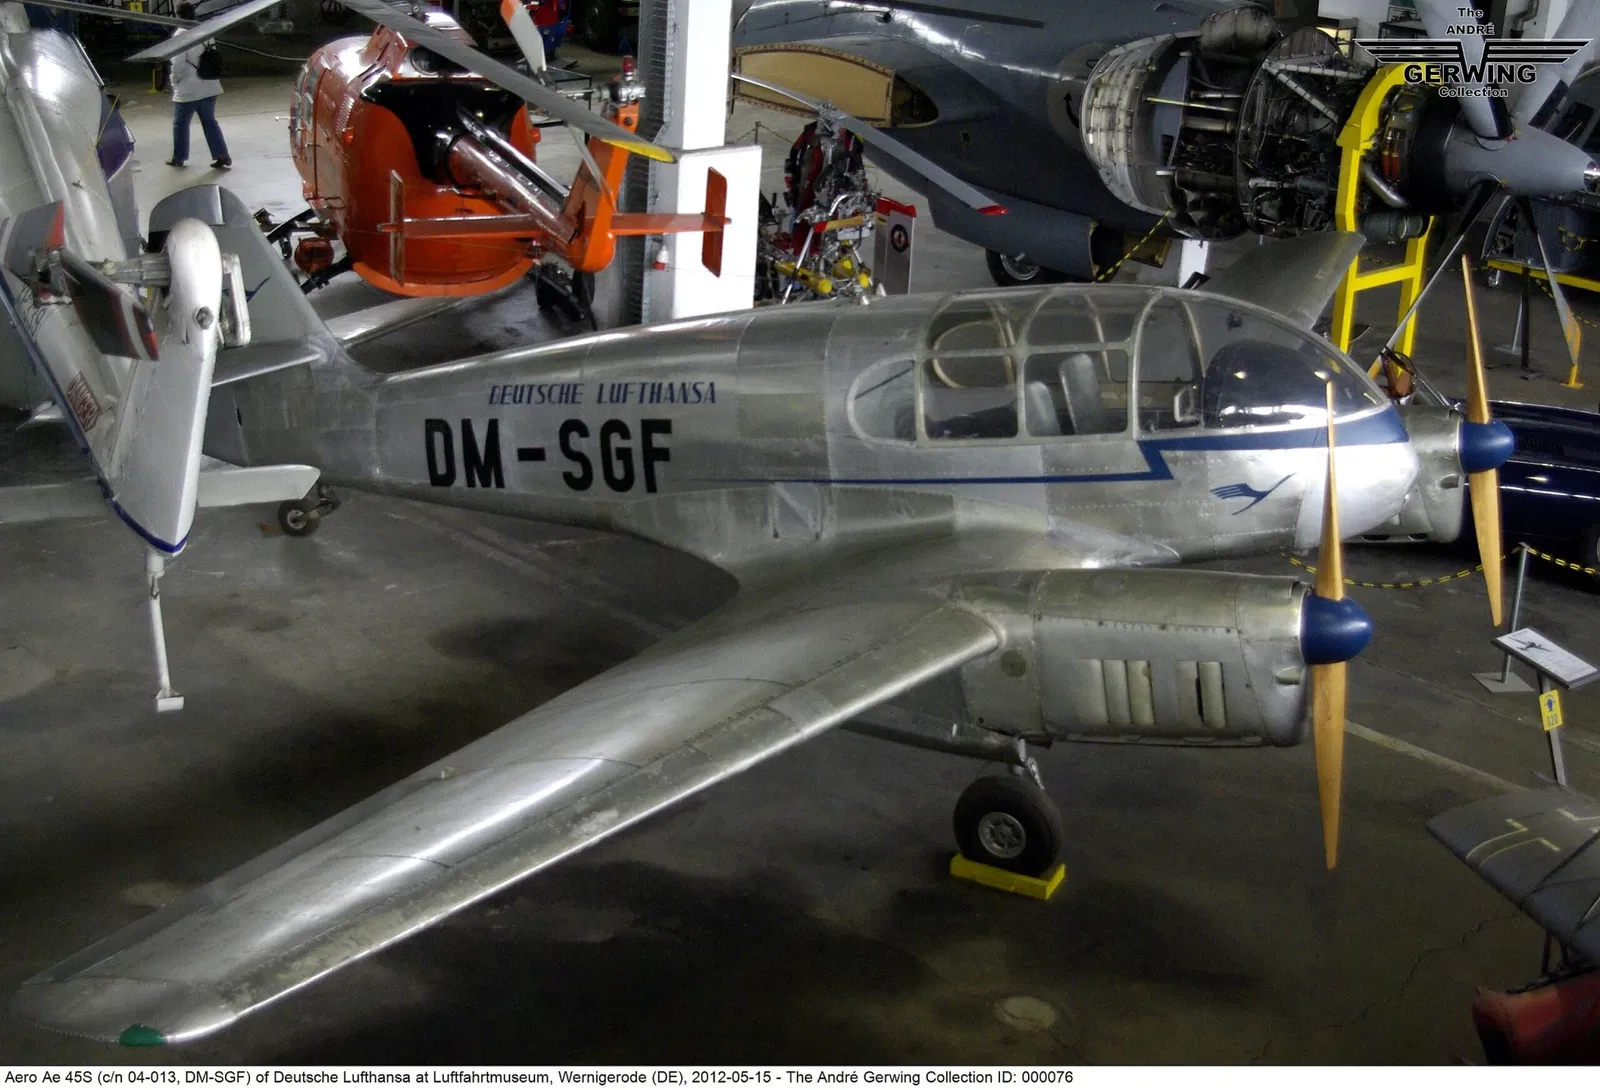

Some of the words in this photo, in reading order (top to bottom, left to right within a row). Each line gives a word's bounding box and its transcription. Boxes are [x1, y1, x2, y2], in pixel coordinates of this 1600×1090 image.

[488, 382, 585, 405] DEUTSCHE
[597, 381, 717, 405] LUFTHANSA
[424, 418, 673, 494] DM-SGF
